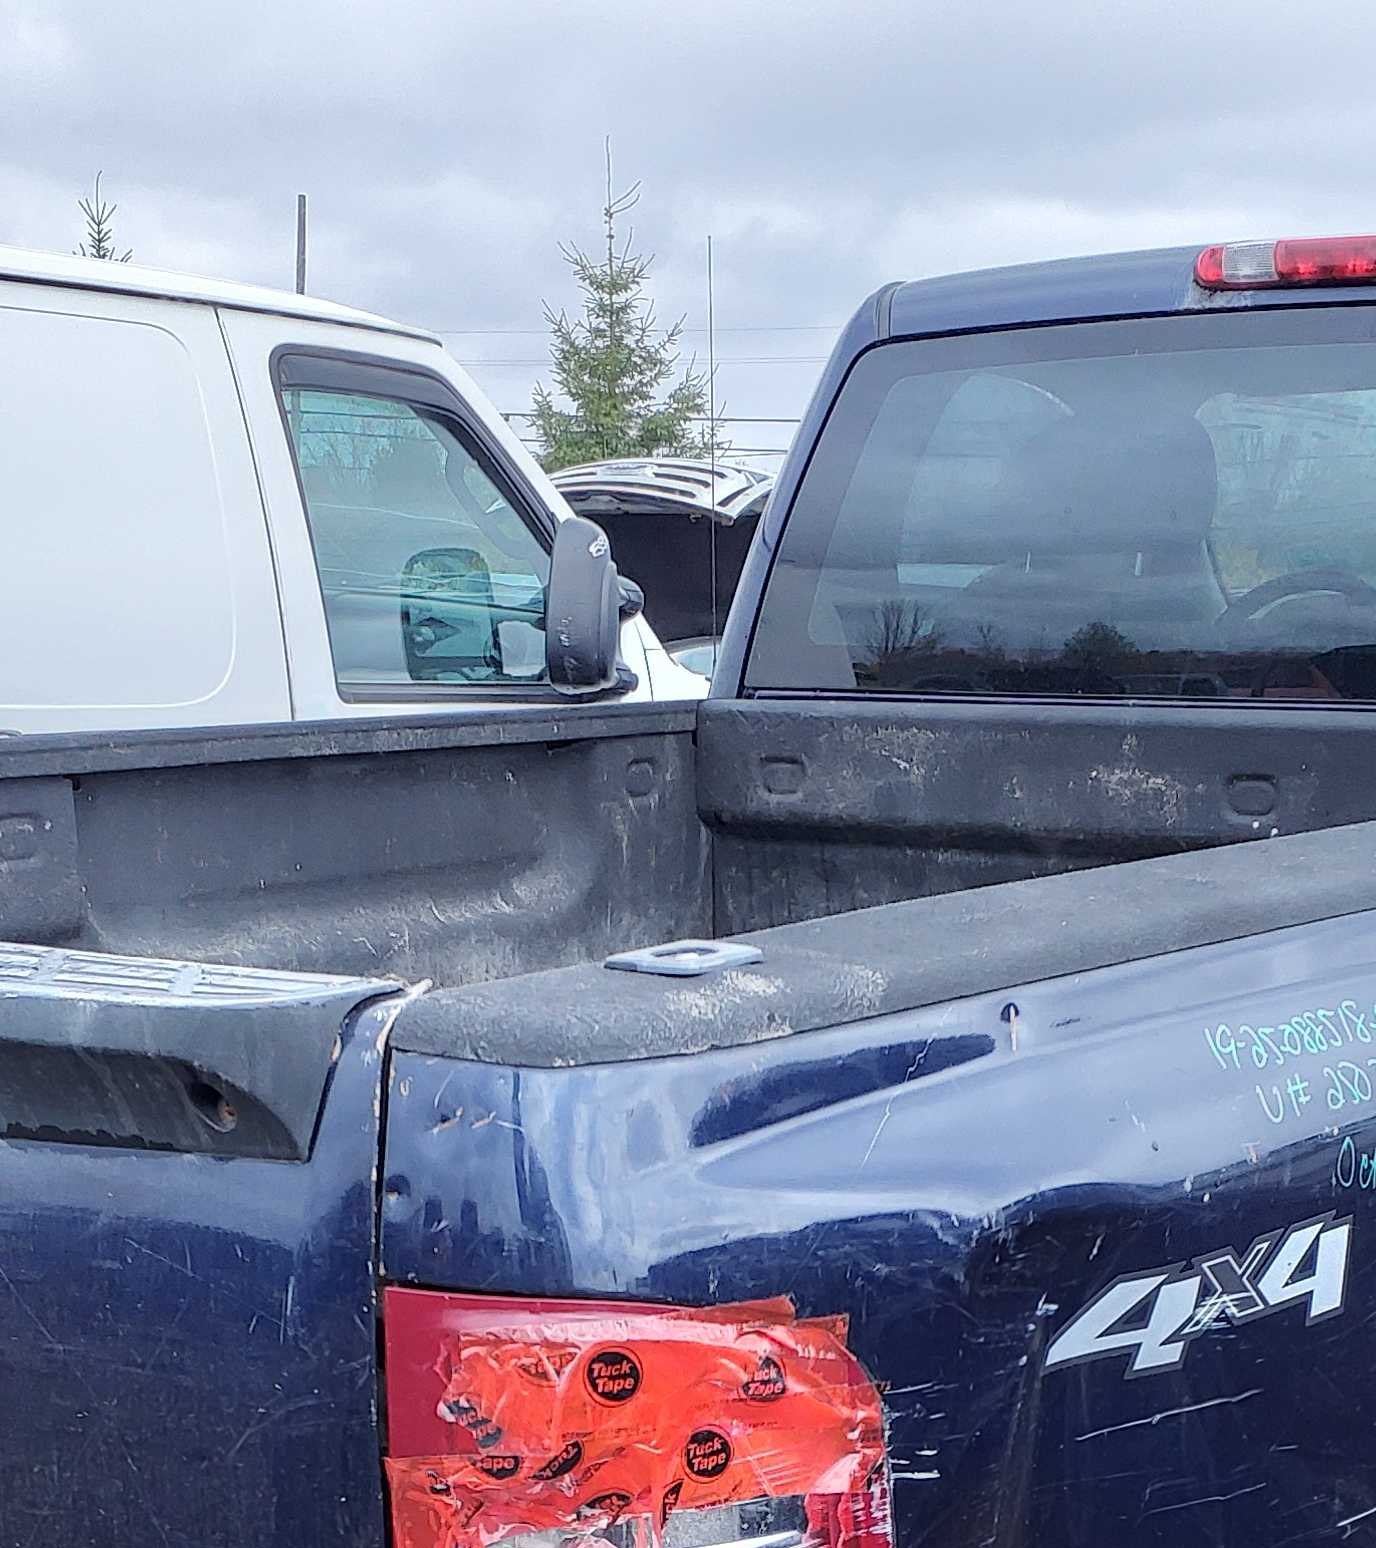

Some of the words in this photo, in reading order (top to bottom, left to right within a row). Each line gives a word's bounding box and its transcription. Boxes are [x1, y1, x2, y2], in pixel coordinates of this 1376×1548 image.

[591, 1360, 634, 1379] Tuck
[595, 1376, 635, 1394] Tape
[747, 1381, 784, 1396] Tape
[687, 1437, 724, 1457] Tuck
[480, 1457, 515, 1472] ape
[692, 1452, 727, 1471] Tape
